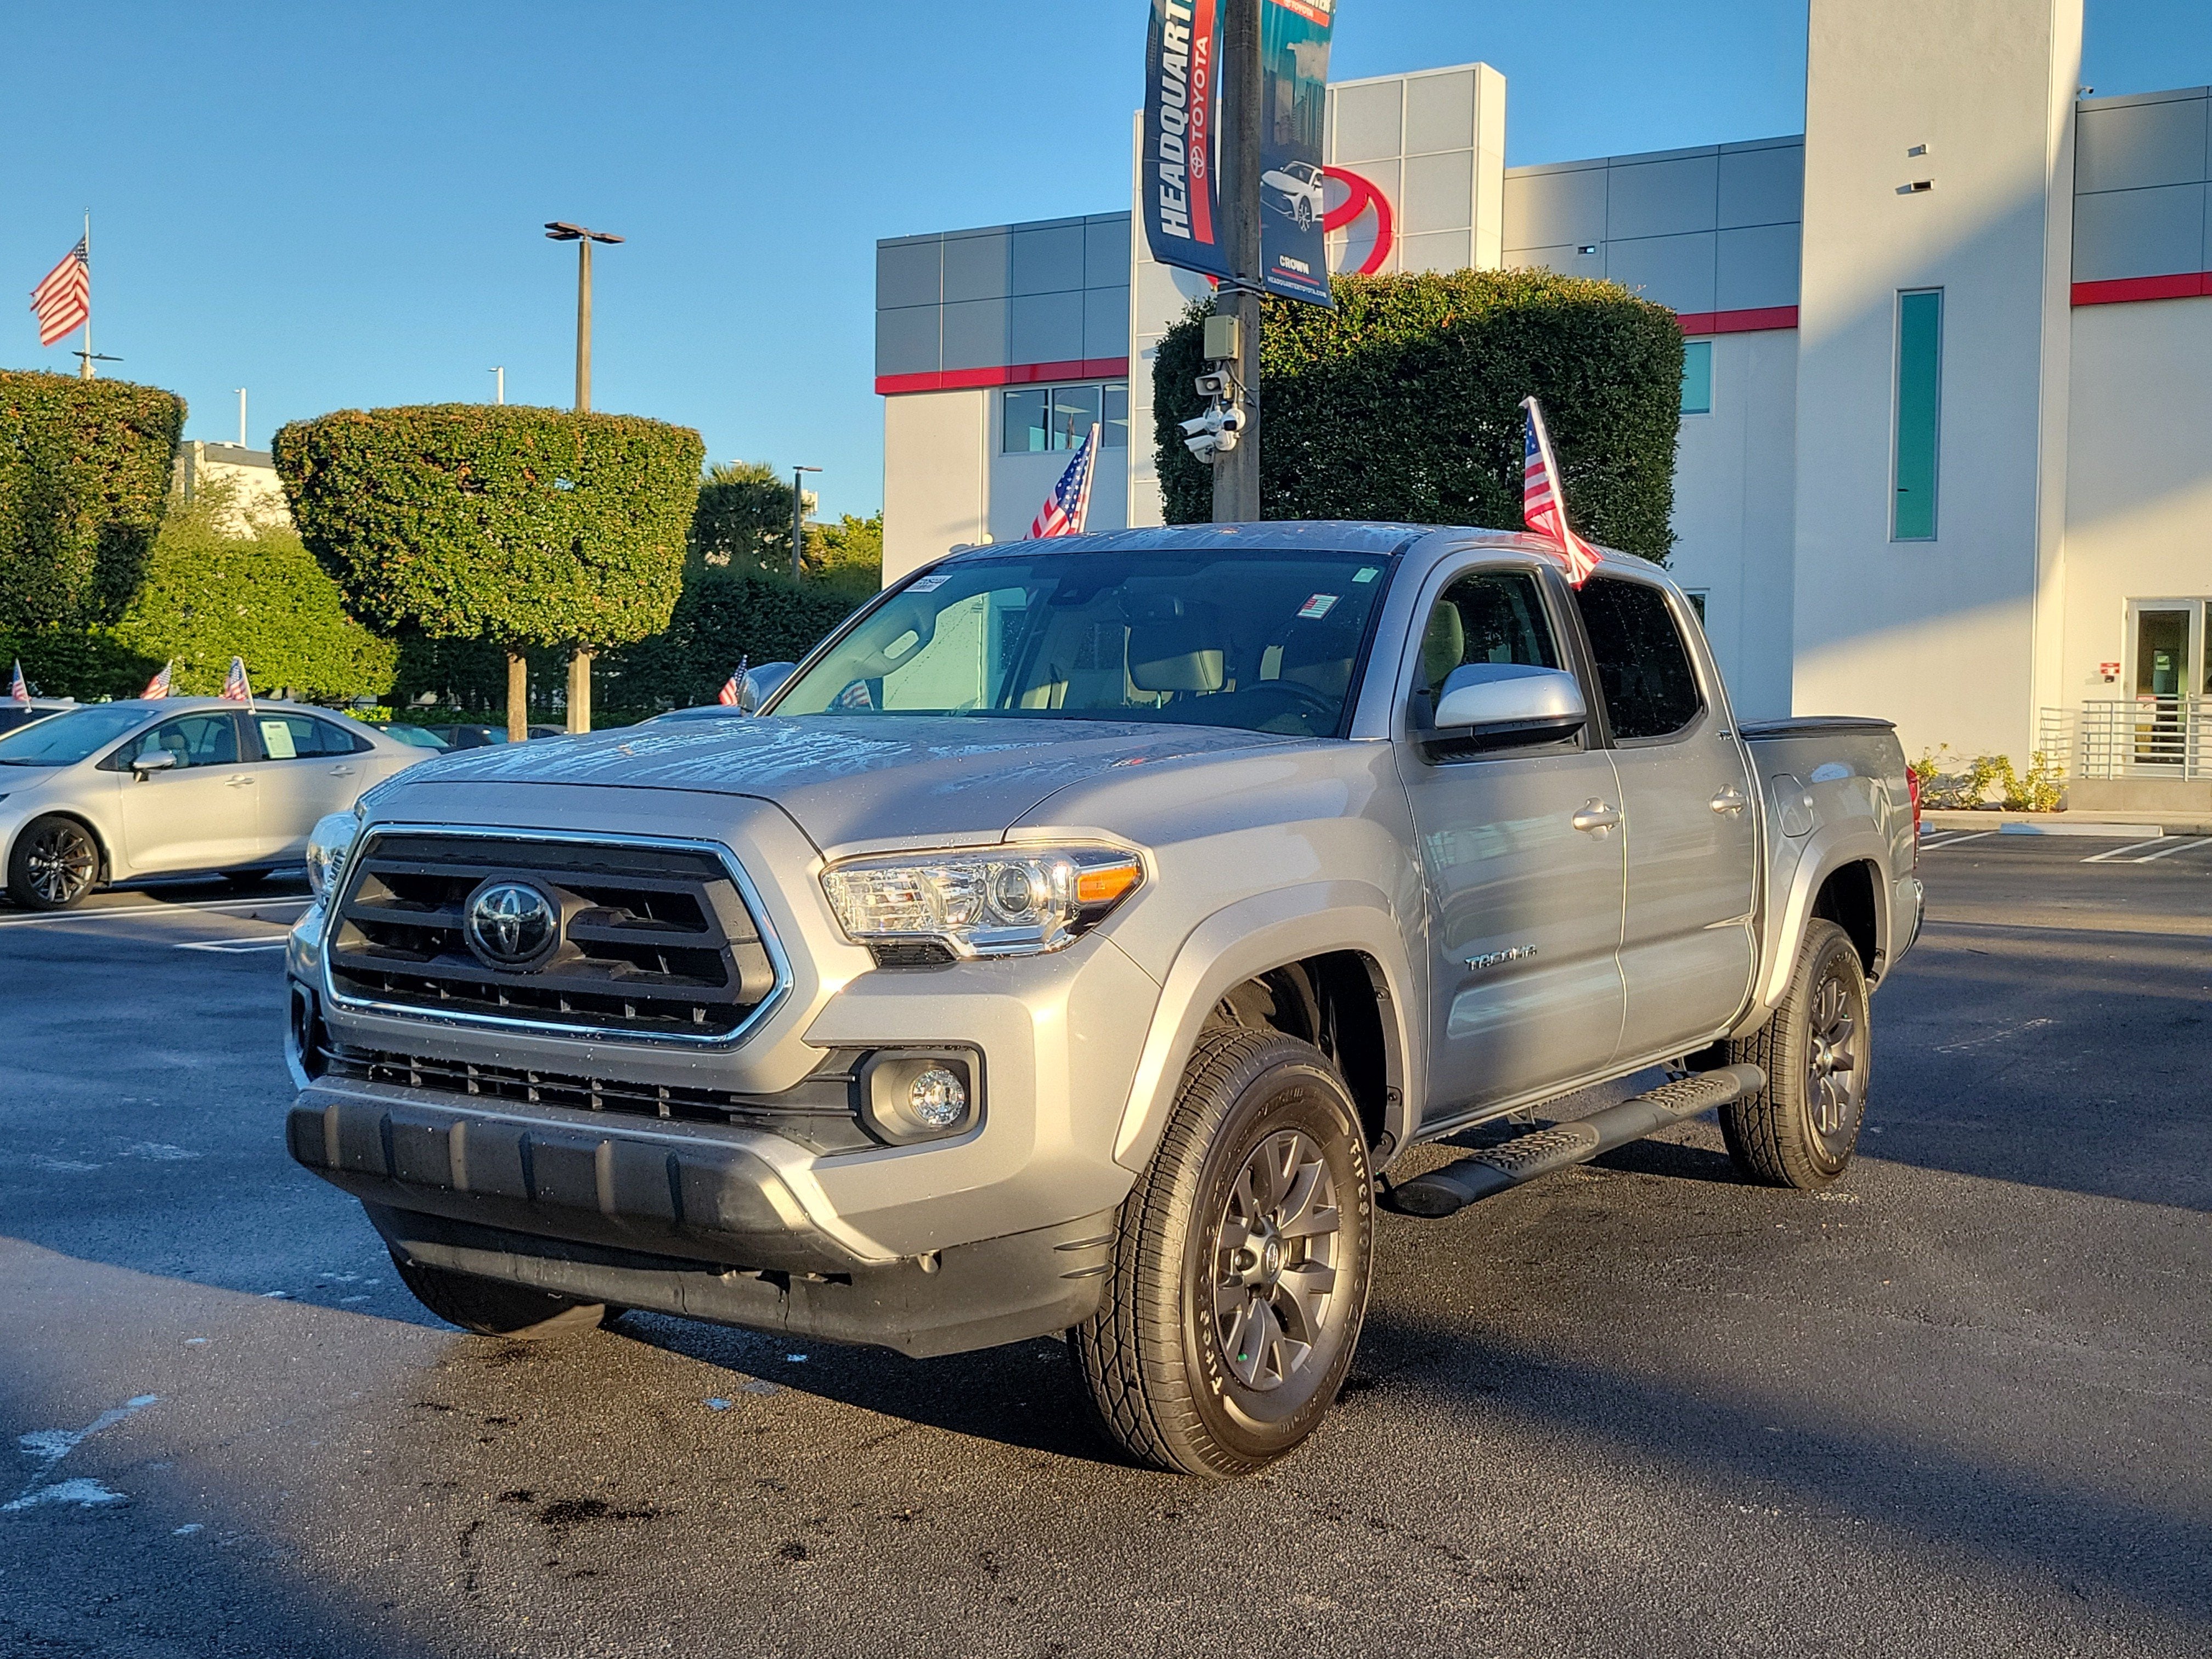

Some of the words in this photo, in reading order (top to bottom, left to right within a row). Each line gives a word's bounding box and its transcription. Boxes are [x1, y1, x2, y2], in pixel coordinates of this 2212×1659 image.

[1291, 1, 1314, 18] TOYOTA
[1160, 0, 1192, 239] HEADQUART
[1192, 36, 1209, 142] TOYOTA
[1279, 255, 1310, 274] CROWN
